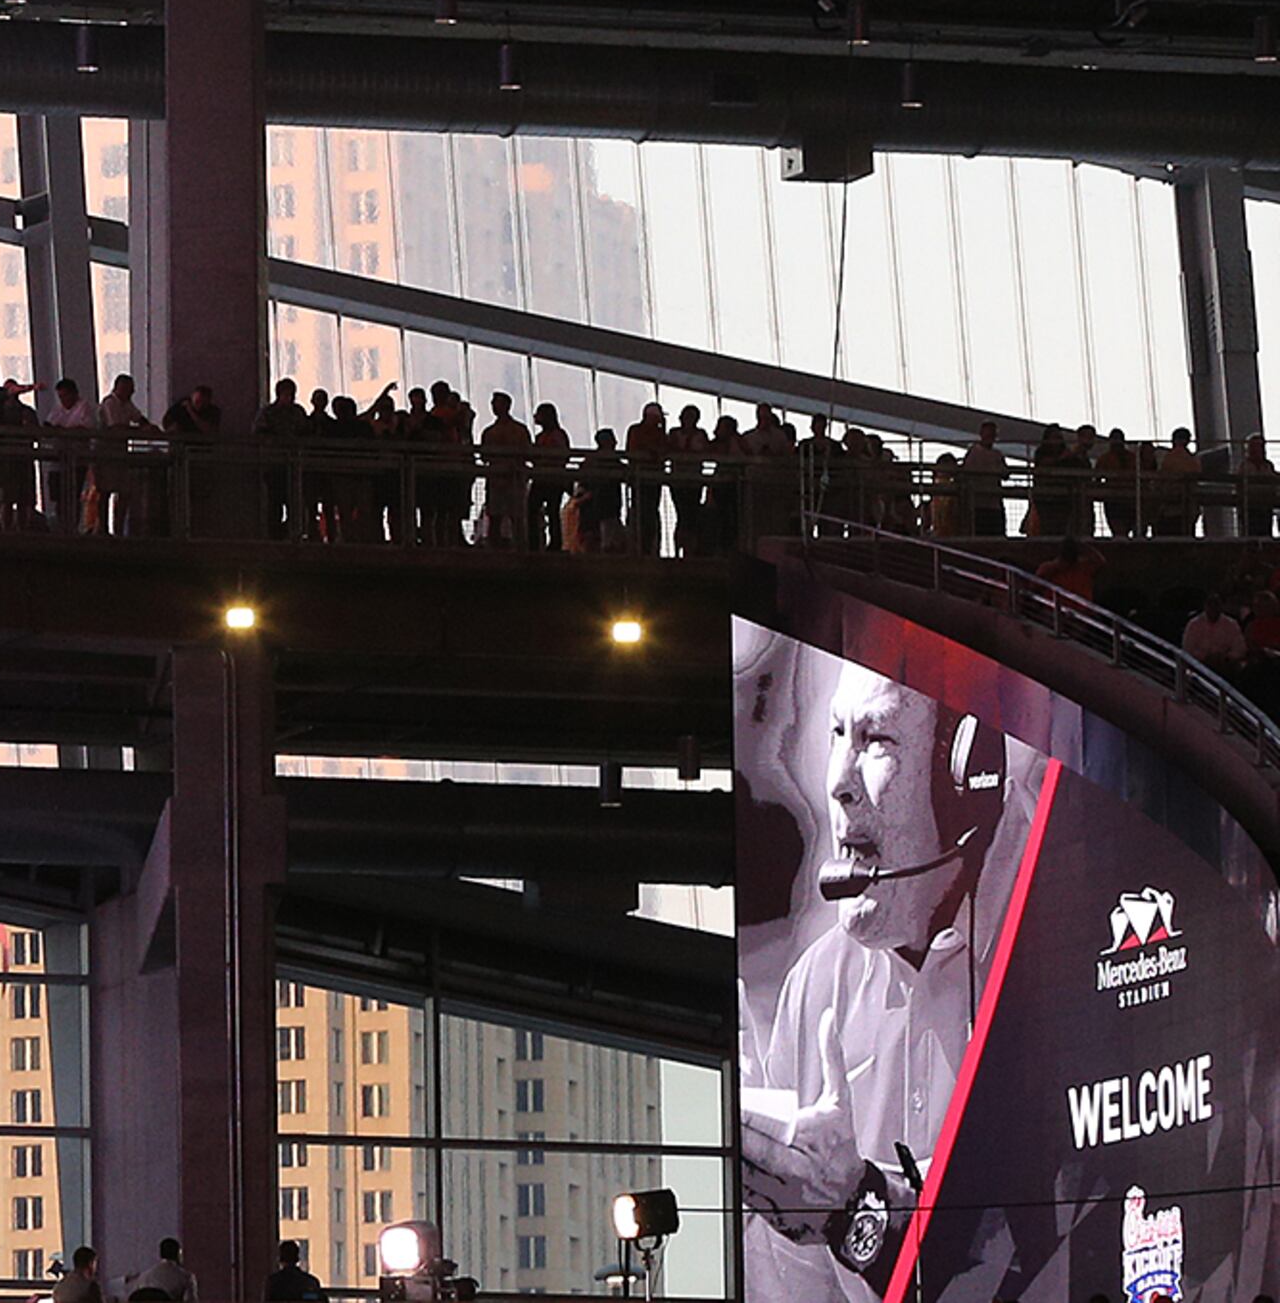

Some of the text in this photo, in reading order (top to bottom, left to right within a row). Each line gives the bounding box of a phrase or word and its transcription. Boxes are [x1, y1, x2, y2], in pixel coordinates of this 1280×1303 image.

[1097, 946, 1187, 990] Mercedes-Benz
[1118, 981, 1170, 1008] STADIUM
[1068, 1054, 1212, 1149] WELCOME
